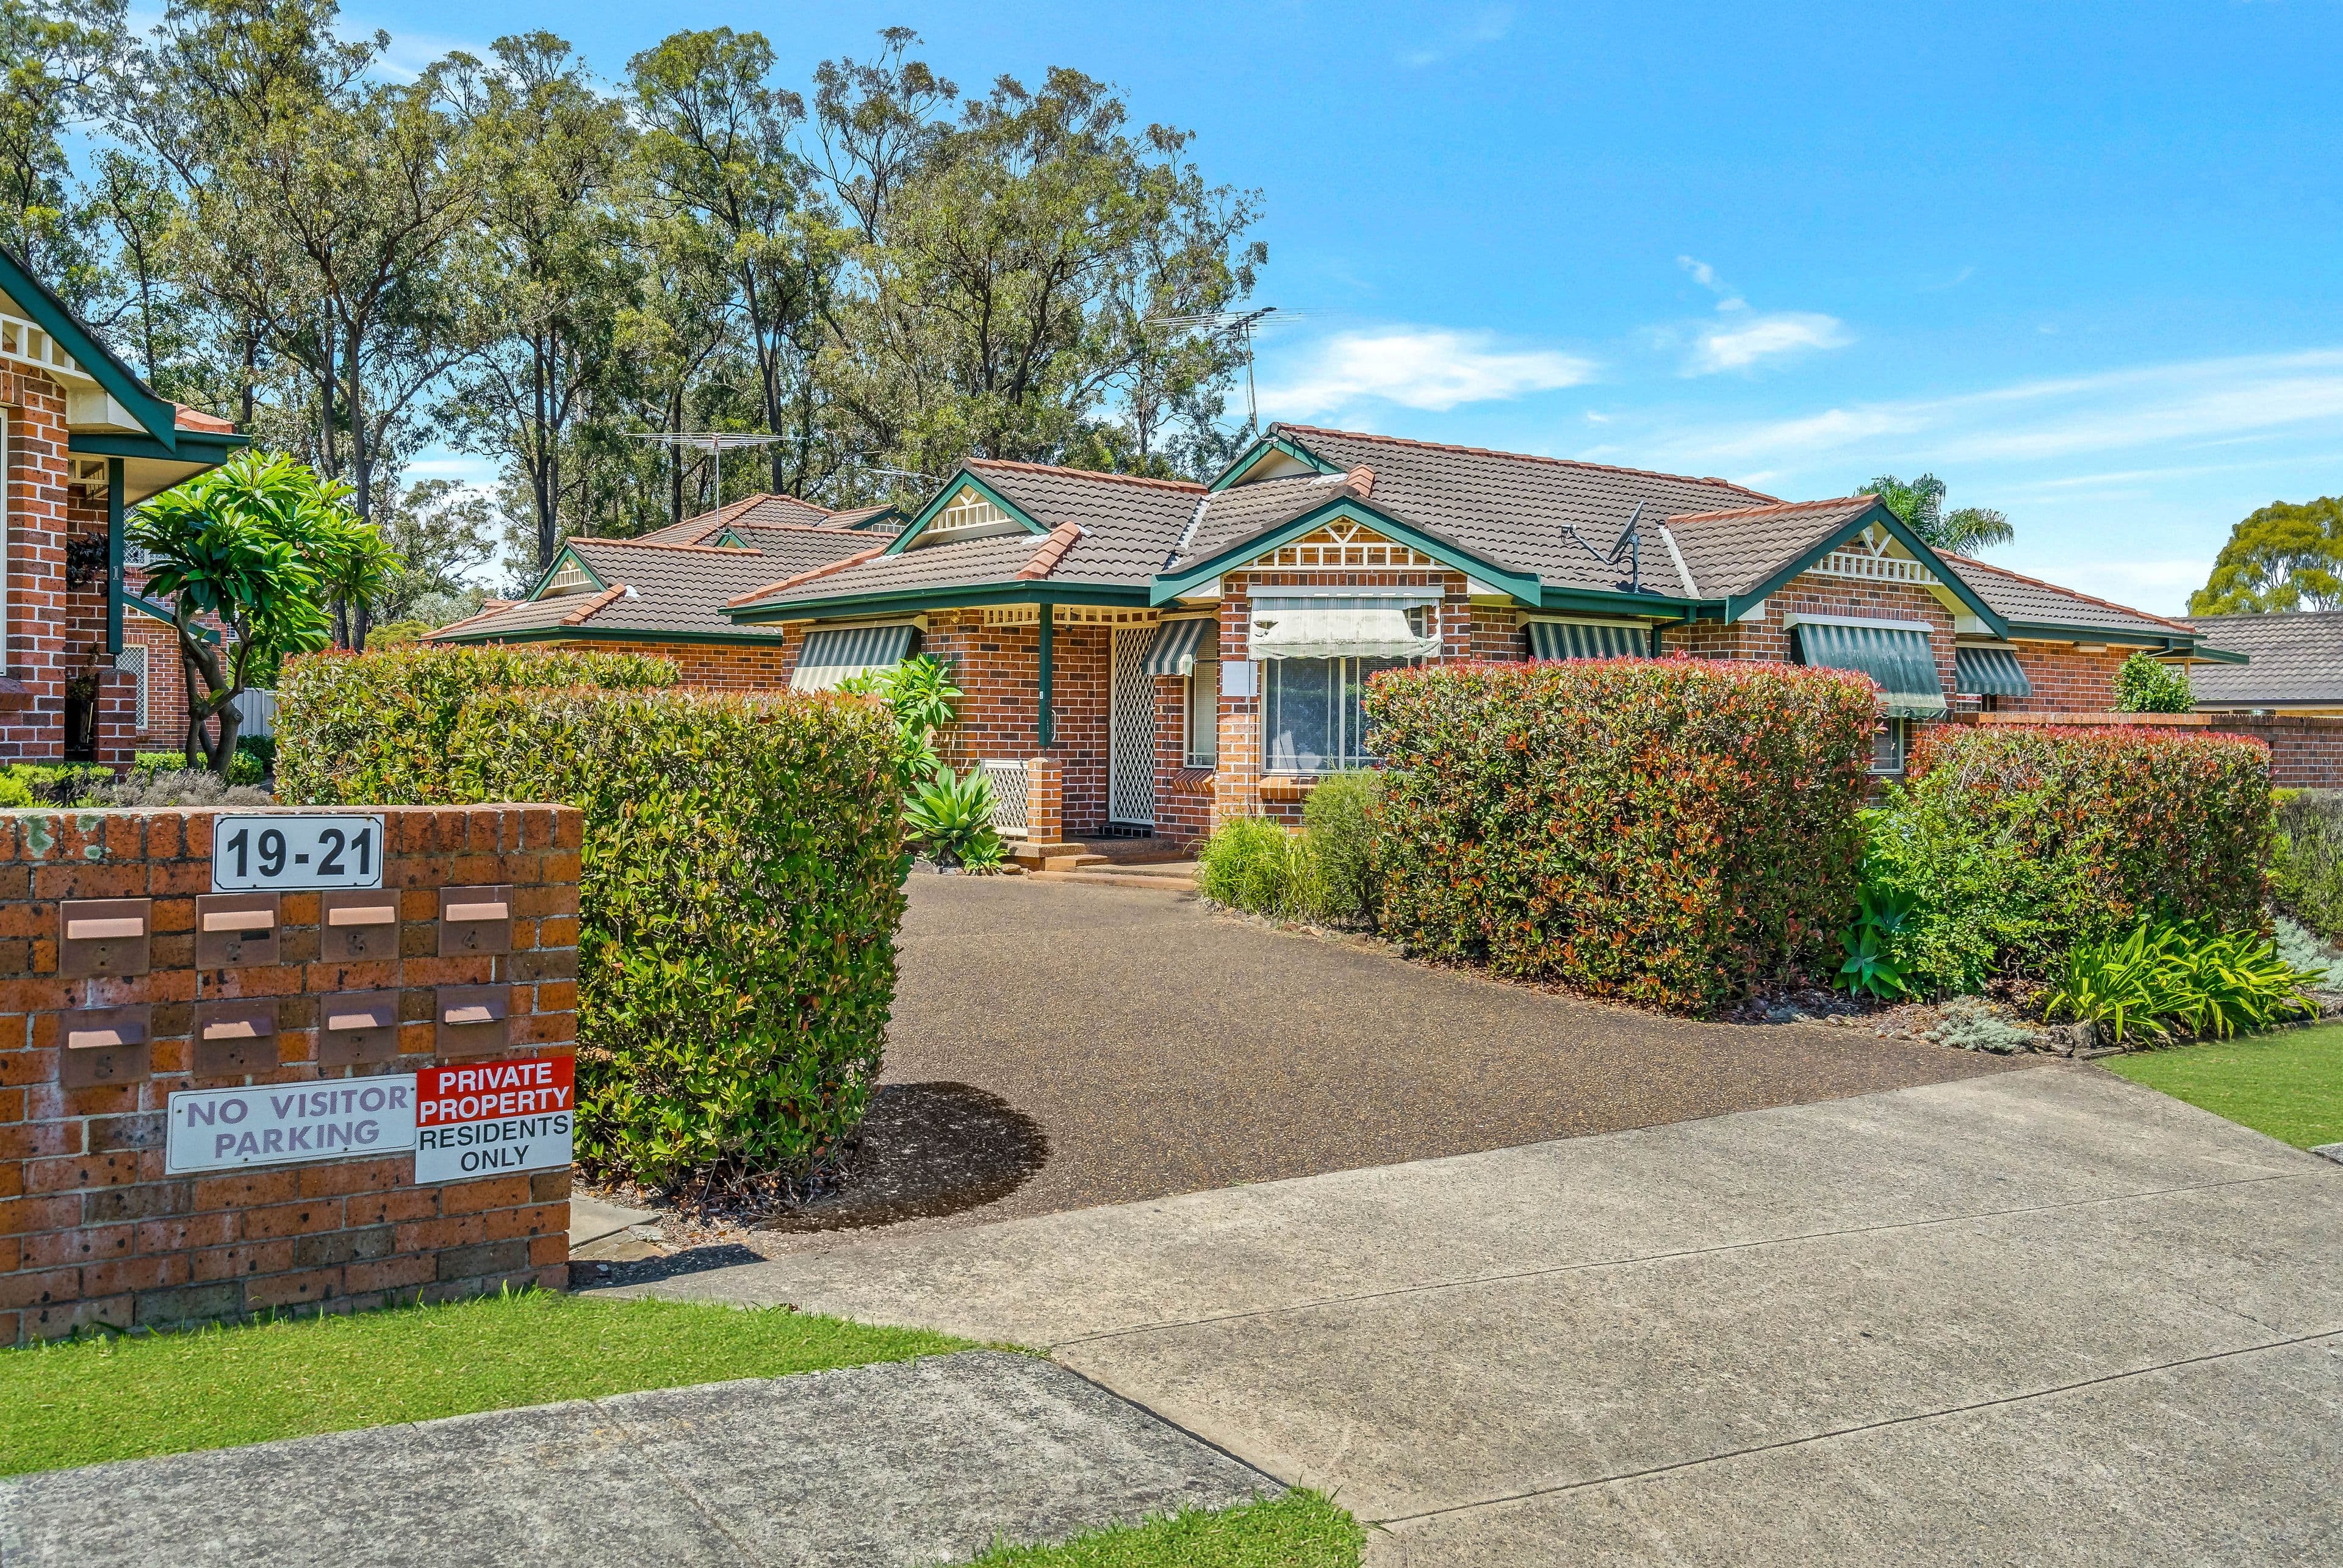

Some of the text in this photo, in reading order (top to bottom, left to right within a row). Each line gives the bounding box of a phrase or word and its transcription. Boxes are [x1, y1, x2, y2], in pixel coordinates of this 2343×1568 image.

[112, 565, 120, 580] 1
[227, 828, 371, 877] 19-21
[439, 1062, 552, 1095] PRIVATE
[187, 1085, 409, 1127] NO VISITOR
[420, 1086, 570, 1123] PROPERTY
[215, 1120, 380, 1159] PARKING
[420, 1115, 569, 1150] RESIDENTS
[461, 1145, 530, 1172] ONLY
